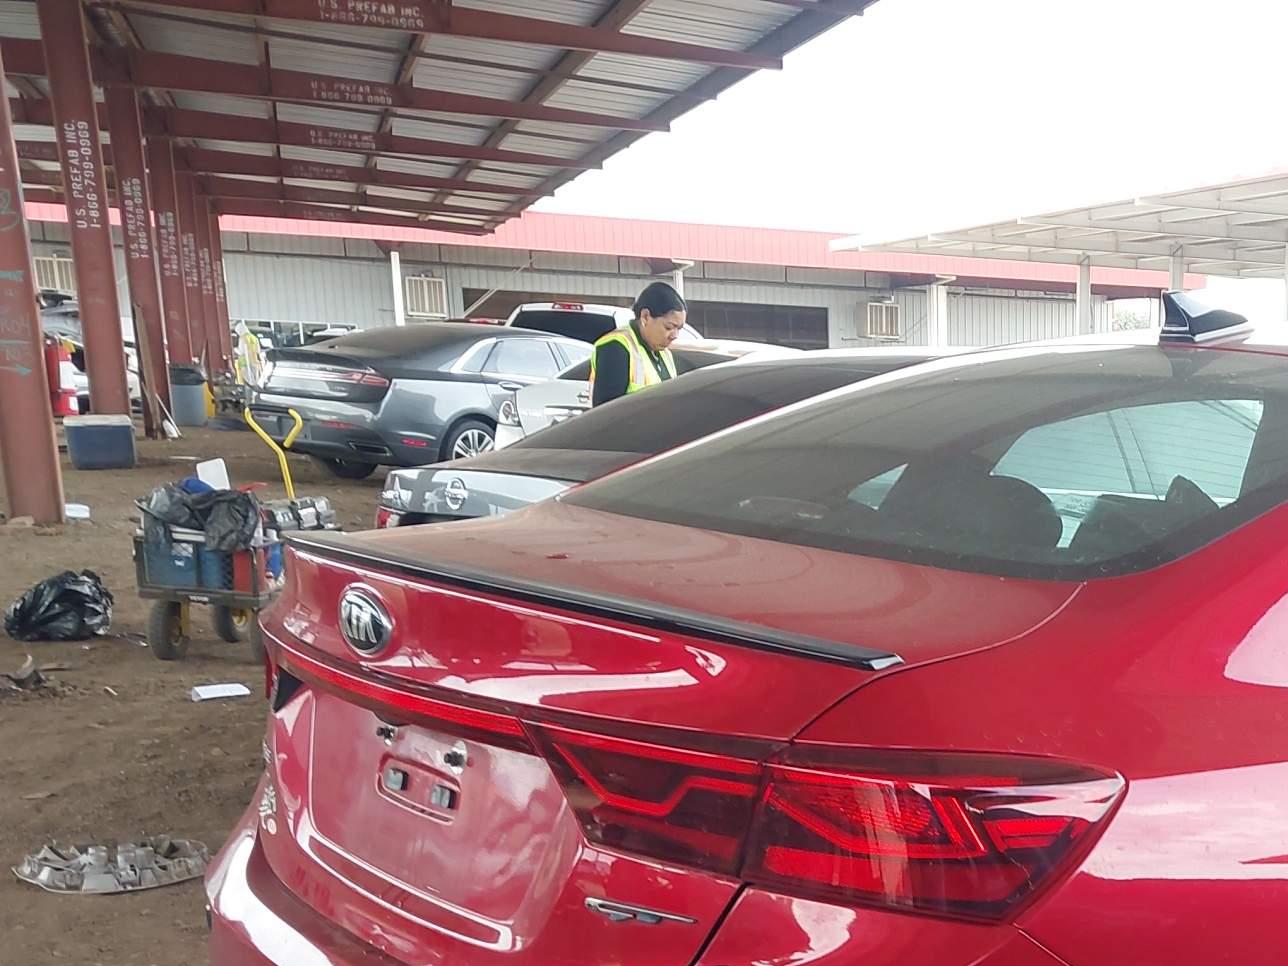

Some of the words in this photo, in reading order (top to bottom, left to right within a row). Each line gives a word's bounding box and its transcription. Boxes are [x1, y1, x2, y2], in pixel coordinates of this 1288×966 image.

[64, 120, 78, 143] INC.
[67, 149, 84, 198] PREFAB
[77, 121, 101, 228] 1-866-799-0969
[75, 205, 88, 229] U.S.
[124, 199, 137, 237] PREFAB
